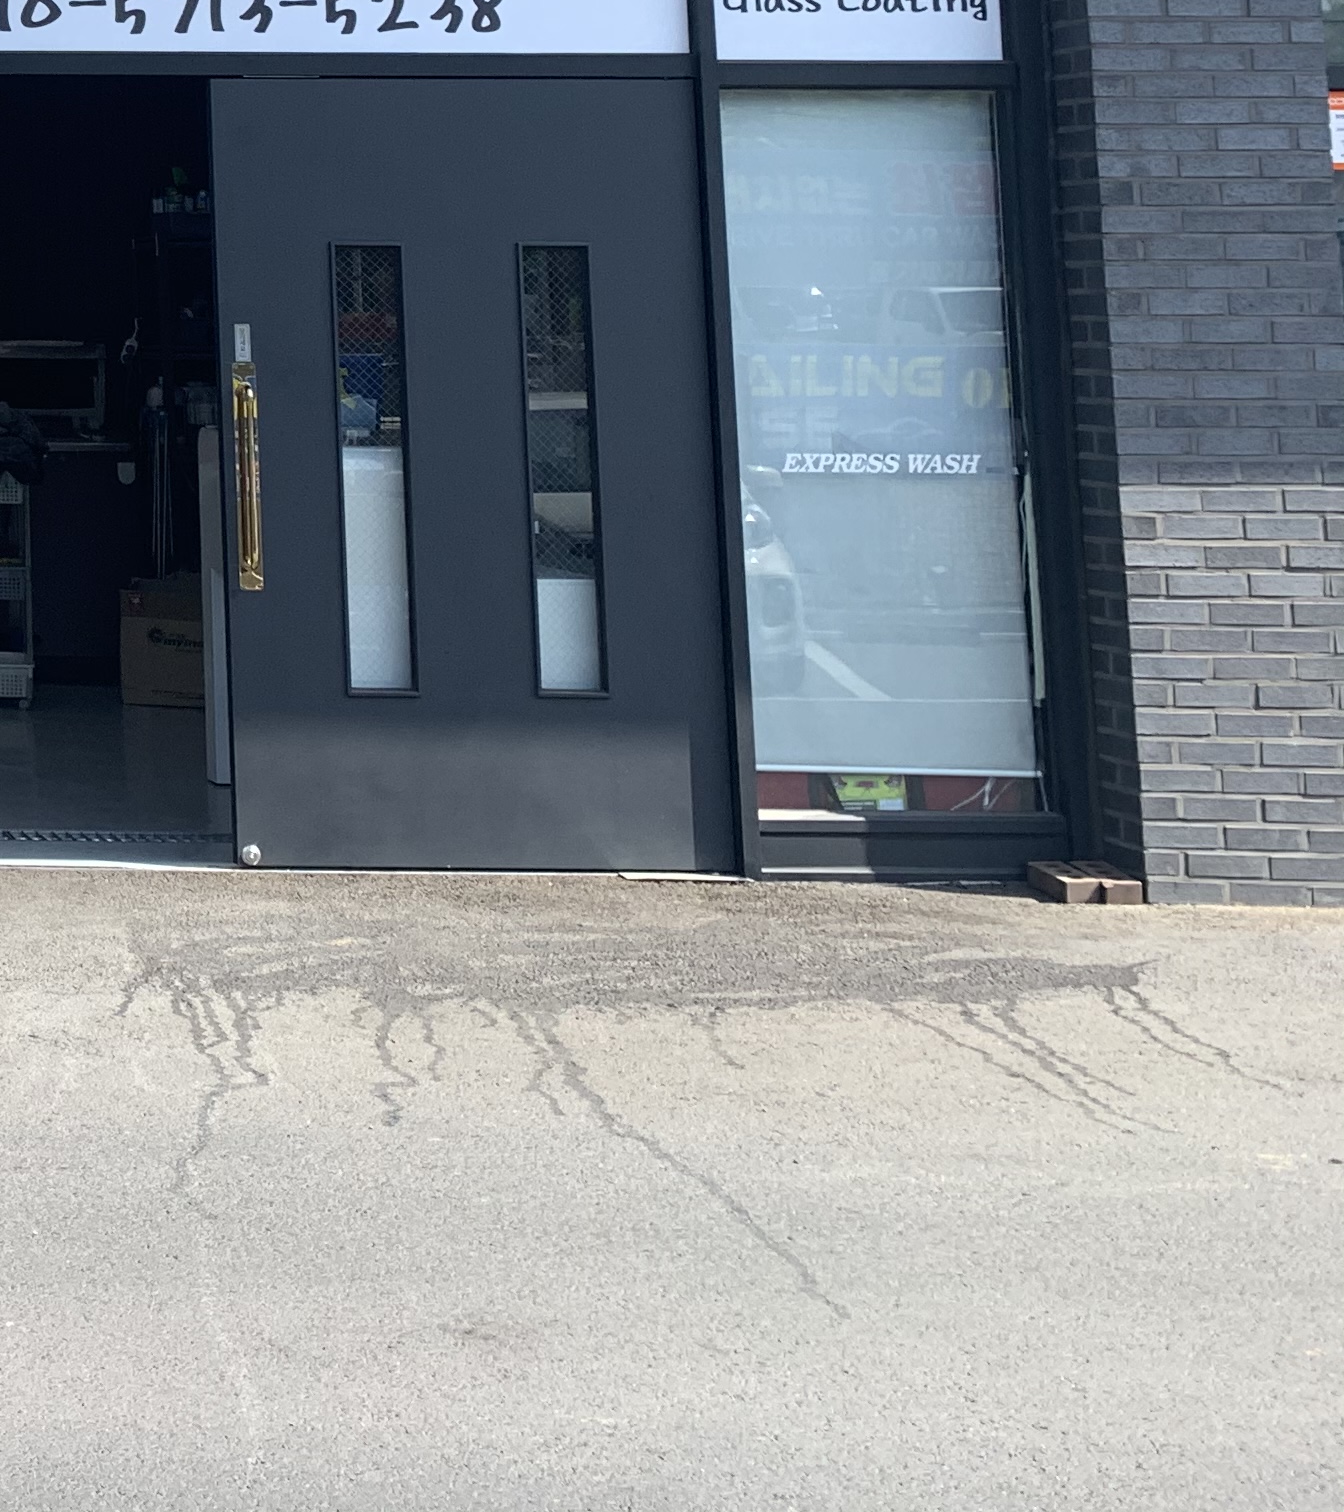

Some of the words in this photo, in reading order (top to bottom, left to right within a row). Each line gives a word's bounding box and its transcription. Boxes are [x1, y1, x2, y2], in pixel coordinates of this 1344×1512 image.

[748, 354, 945, 398] AILING
[782, 453, 900, 474] EXPRESS
[907, 453, 981, 474] WASH
